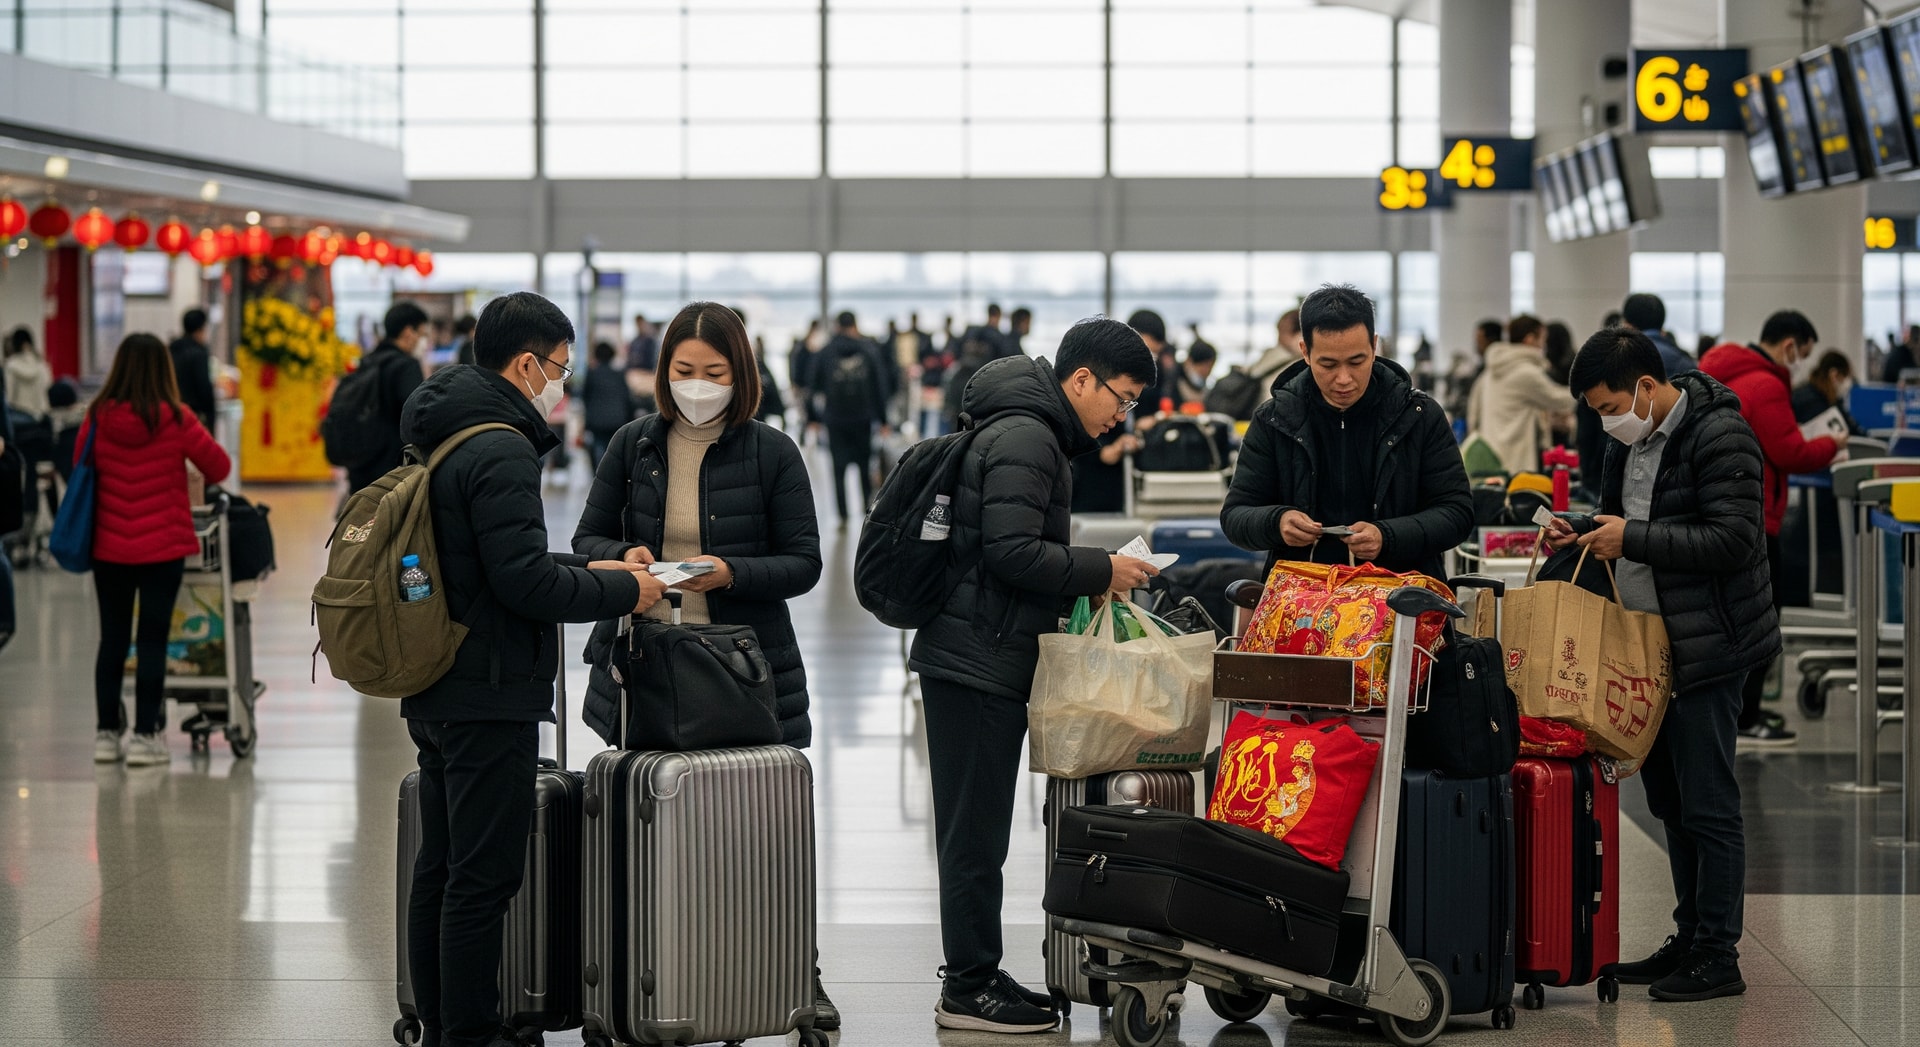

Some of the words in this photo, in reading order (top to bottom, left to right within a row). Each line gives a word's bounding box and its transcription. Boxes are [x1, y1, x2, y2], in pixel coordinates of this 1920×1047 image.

[1636, 56, 1683, 122] 6
[1379, 166, 1410, 210] 3
[1440, 139, 1476, 188] 4
